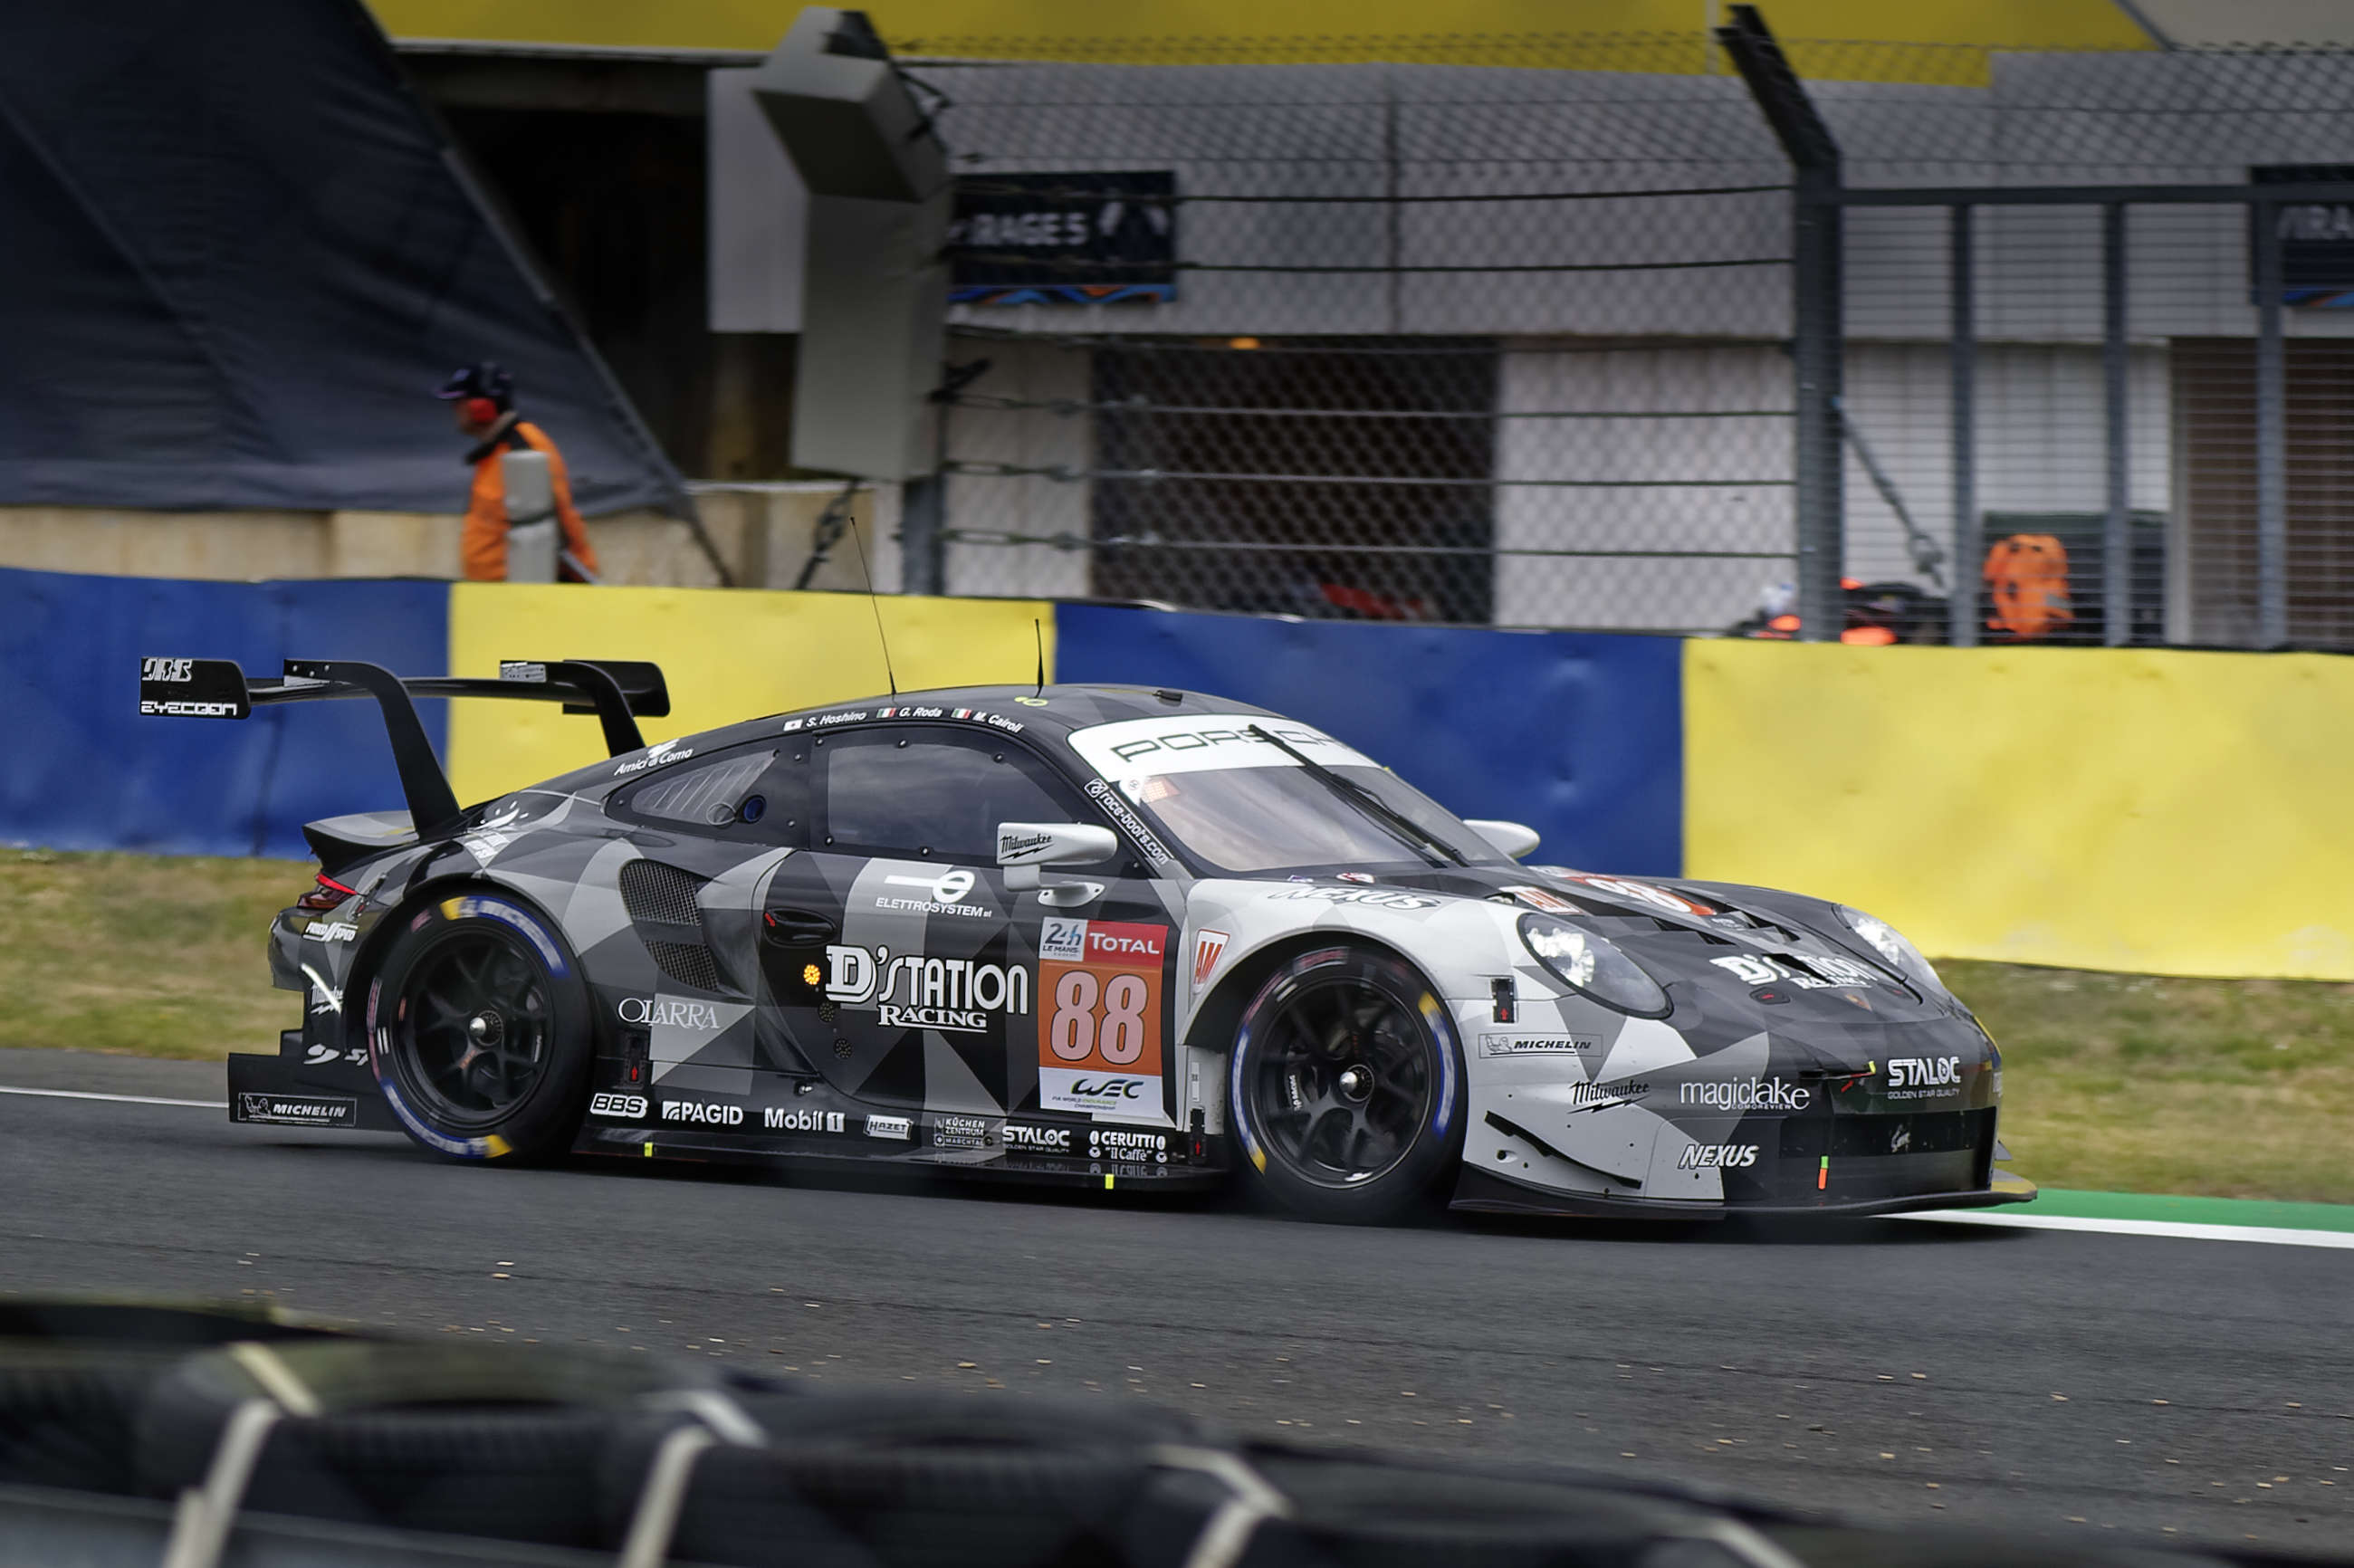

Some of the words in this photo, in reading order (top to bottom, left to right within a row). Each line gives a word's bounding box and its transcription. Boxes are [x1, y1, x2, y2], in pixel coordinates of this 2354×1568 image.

[807, 716, 818, 727] S.
[819, 712, 867, 725] Hoshino
[914, 707, 943, 718] Roda
[972, 712, 987, 722] M.
[614, 758, 647, 776] Amici
[659, 748, 694, 764] Como
[1098, 791, 1170, 865] race-boots.com
[1000, 833, 1052, 854] Milwaukee
[876, 897, 984, 918] ELETTROSYSTEM
[1268, 885, 1441, 910] NEXUS
[1044, 923, 1082, 946] 24h
[1089, 932, 1160, 954] TOTAL
[617, 998, 721, 1030] OLARRA
[877, 1005, 988, 1028] RACING
[1050, 970, 1148, 1066] 88
[1514, 1040, 1592, 1049] MICHELIN
[1888, 1056, 1961, 1086] STALOC
[1071, 1078, 1144, 1099] WEC
[1568, 1079, 1650, 1104] Milwaukee
[1680, 1076, 1810, 1111] magiclake
[1888, 1090, 1918, 1100] GOLDEN
[1919, 1089, 1936, 1098] STAR
[273, 1104, 347, 1118] MICHELIN
[591, 1094, 646, 1117] BBS
[681, 1103, 743, 1125] PAGID
[764, 1107, 823, 1131] Mobil
[827, 1112, 845, 1133] 1
[869, 1121, 907, 1132] HAZET
[945, 1116, 985, 1129] KÜCHEN
[944, 1127, 984, 1137] ZENTRUM
[1002, 1126, 1070, 1147] STALOC
[1101, 1132, 1156, 1148] CERUTTI
[1677, 1144, 1759, 1170] NEXUS
